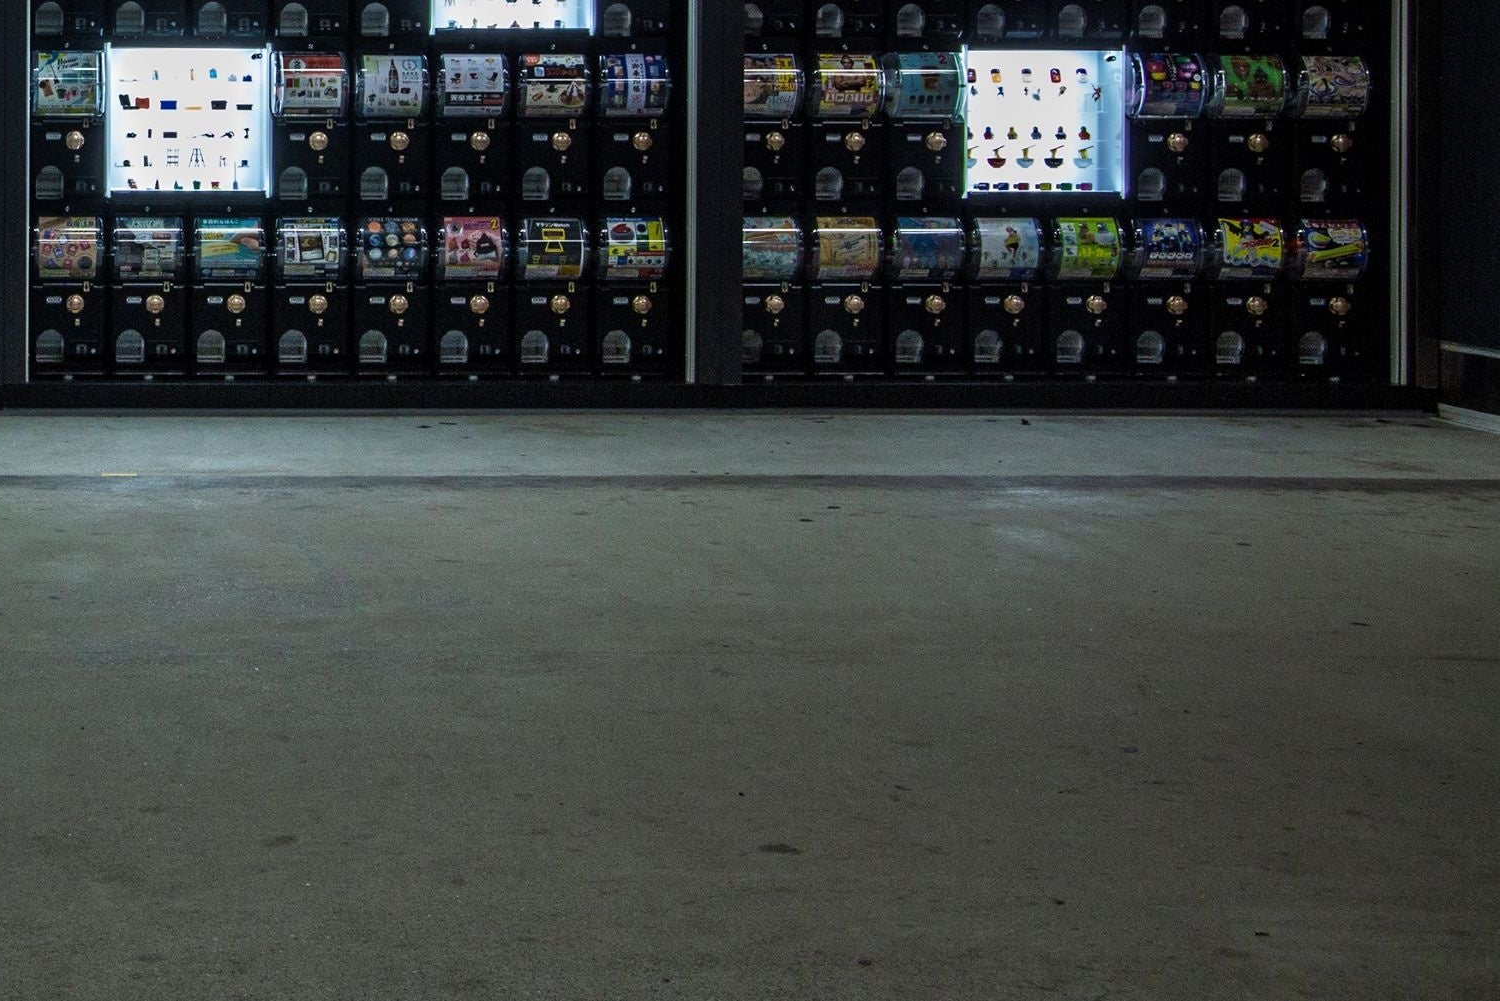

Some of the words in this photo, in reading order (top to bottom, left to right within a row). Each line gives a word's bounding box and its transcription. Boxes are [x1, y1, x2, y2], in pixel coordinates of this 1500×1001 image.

[938, 55, 947, 64] 2
[489, 217, 499, 230] 2
[1272, 239, 1280, 248] 2
